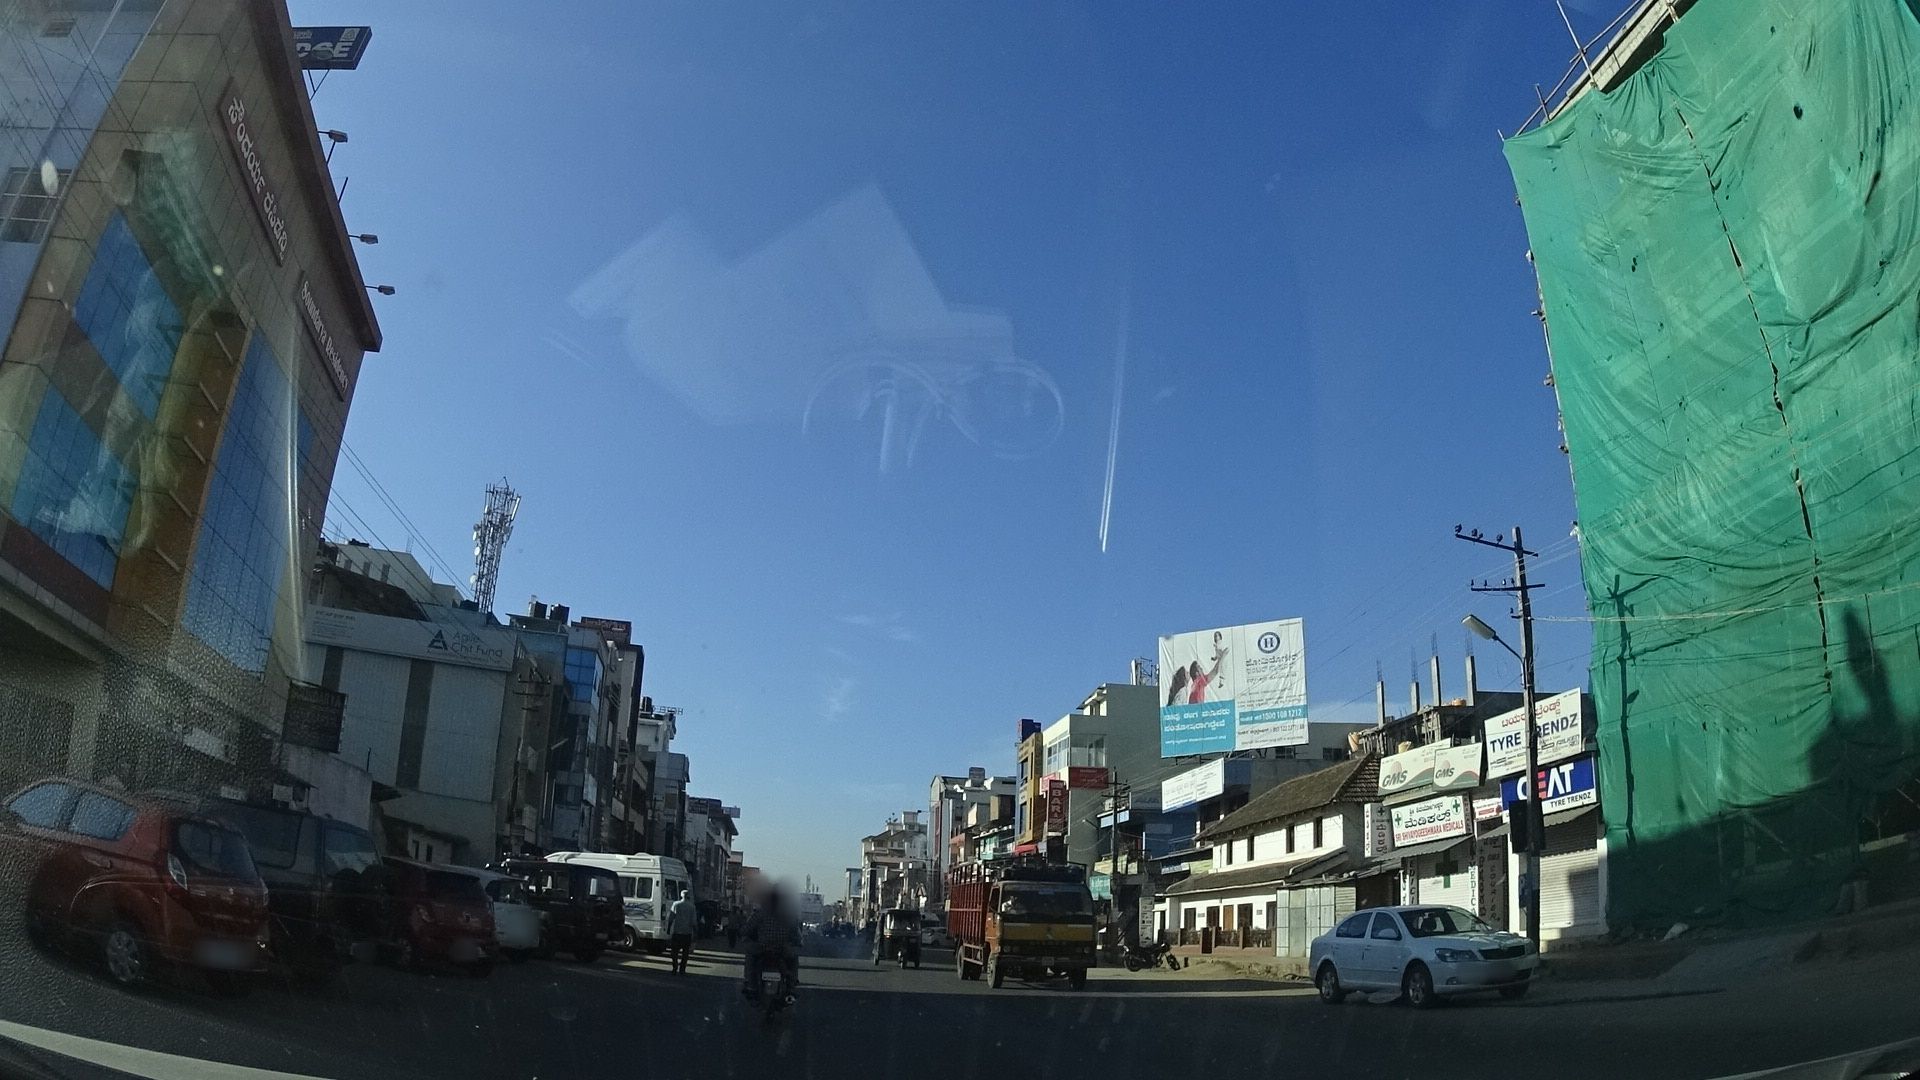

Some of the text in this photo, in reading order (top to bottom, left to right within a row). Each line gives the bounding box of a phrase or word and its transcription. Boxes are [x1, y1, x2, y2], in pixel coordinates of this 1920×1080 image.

[1489, 731, 1521, 754] TYRE
[1535, 713, 1578, 739] RENDZ
[1382, 770, 1408, 787] GMS
[1435, 767, 1455, 779] GMS
[1051, 789, 1062, 813] BAR
[1550, 791, 1592, 808] TYRE TRENDZ
[1443, 820, 1464, 832] MEDICALS
